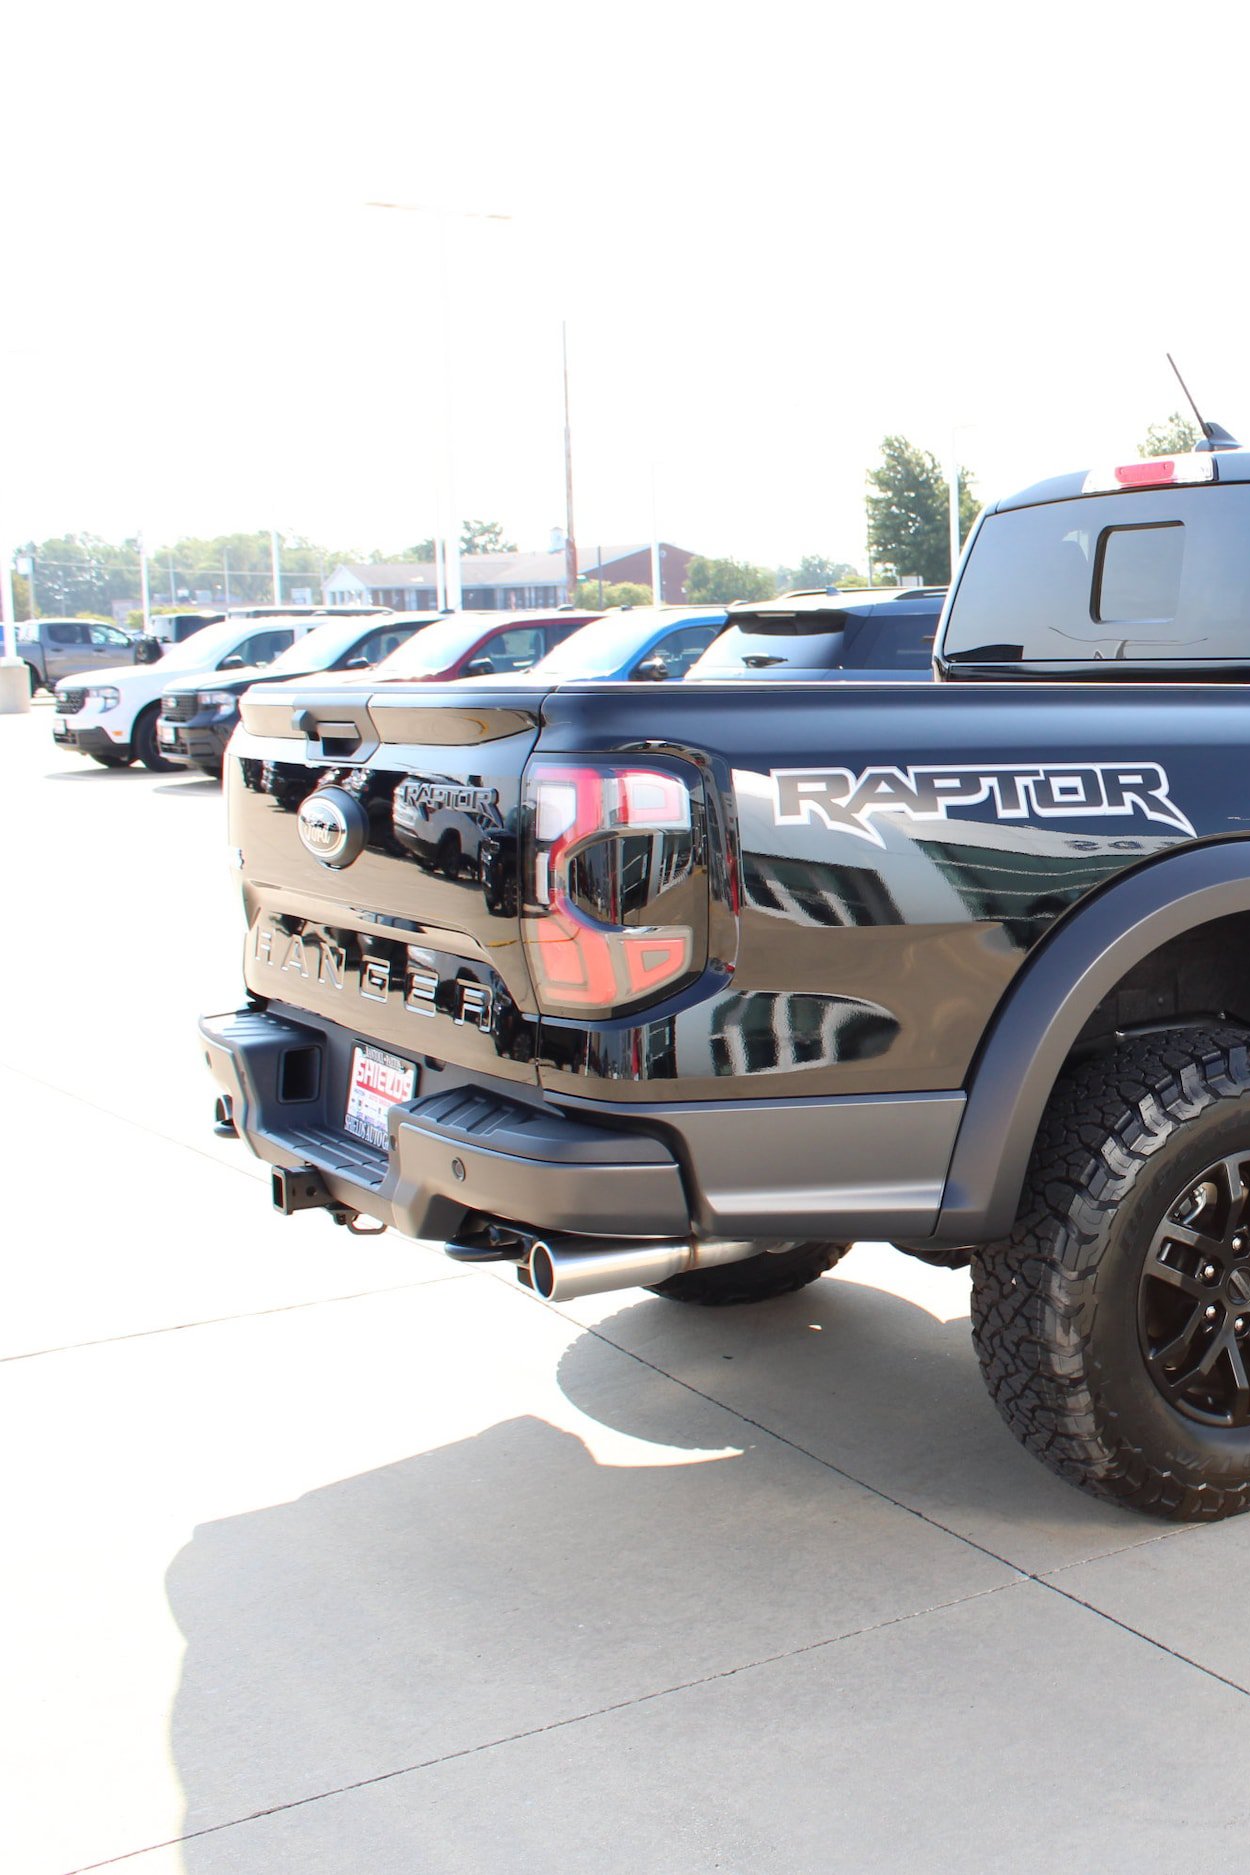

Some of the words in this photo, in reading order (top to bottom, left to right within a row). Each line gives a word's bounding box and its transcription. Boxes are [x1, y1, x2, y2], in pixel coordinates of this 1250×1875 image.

[402, 782, 504, 829] RAPTOR
[770, 761, 1197, 849] RAPTOR
[254, 926, 493, 1033] RANGER
[356, 1060, 412, 1100] SHIELDS
